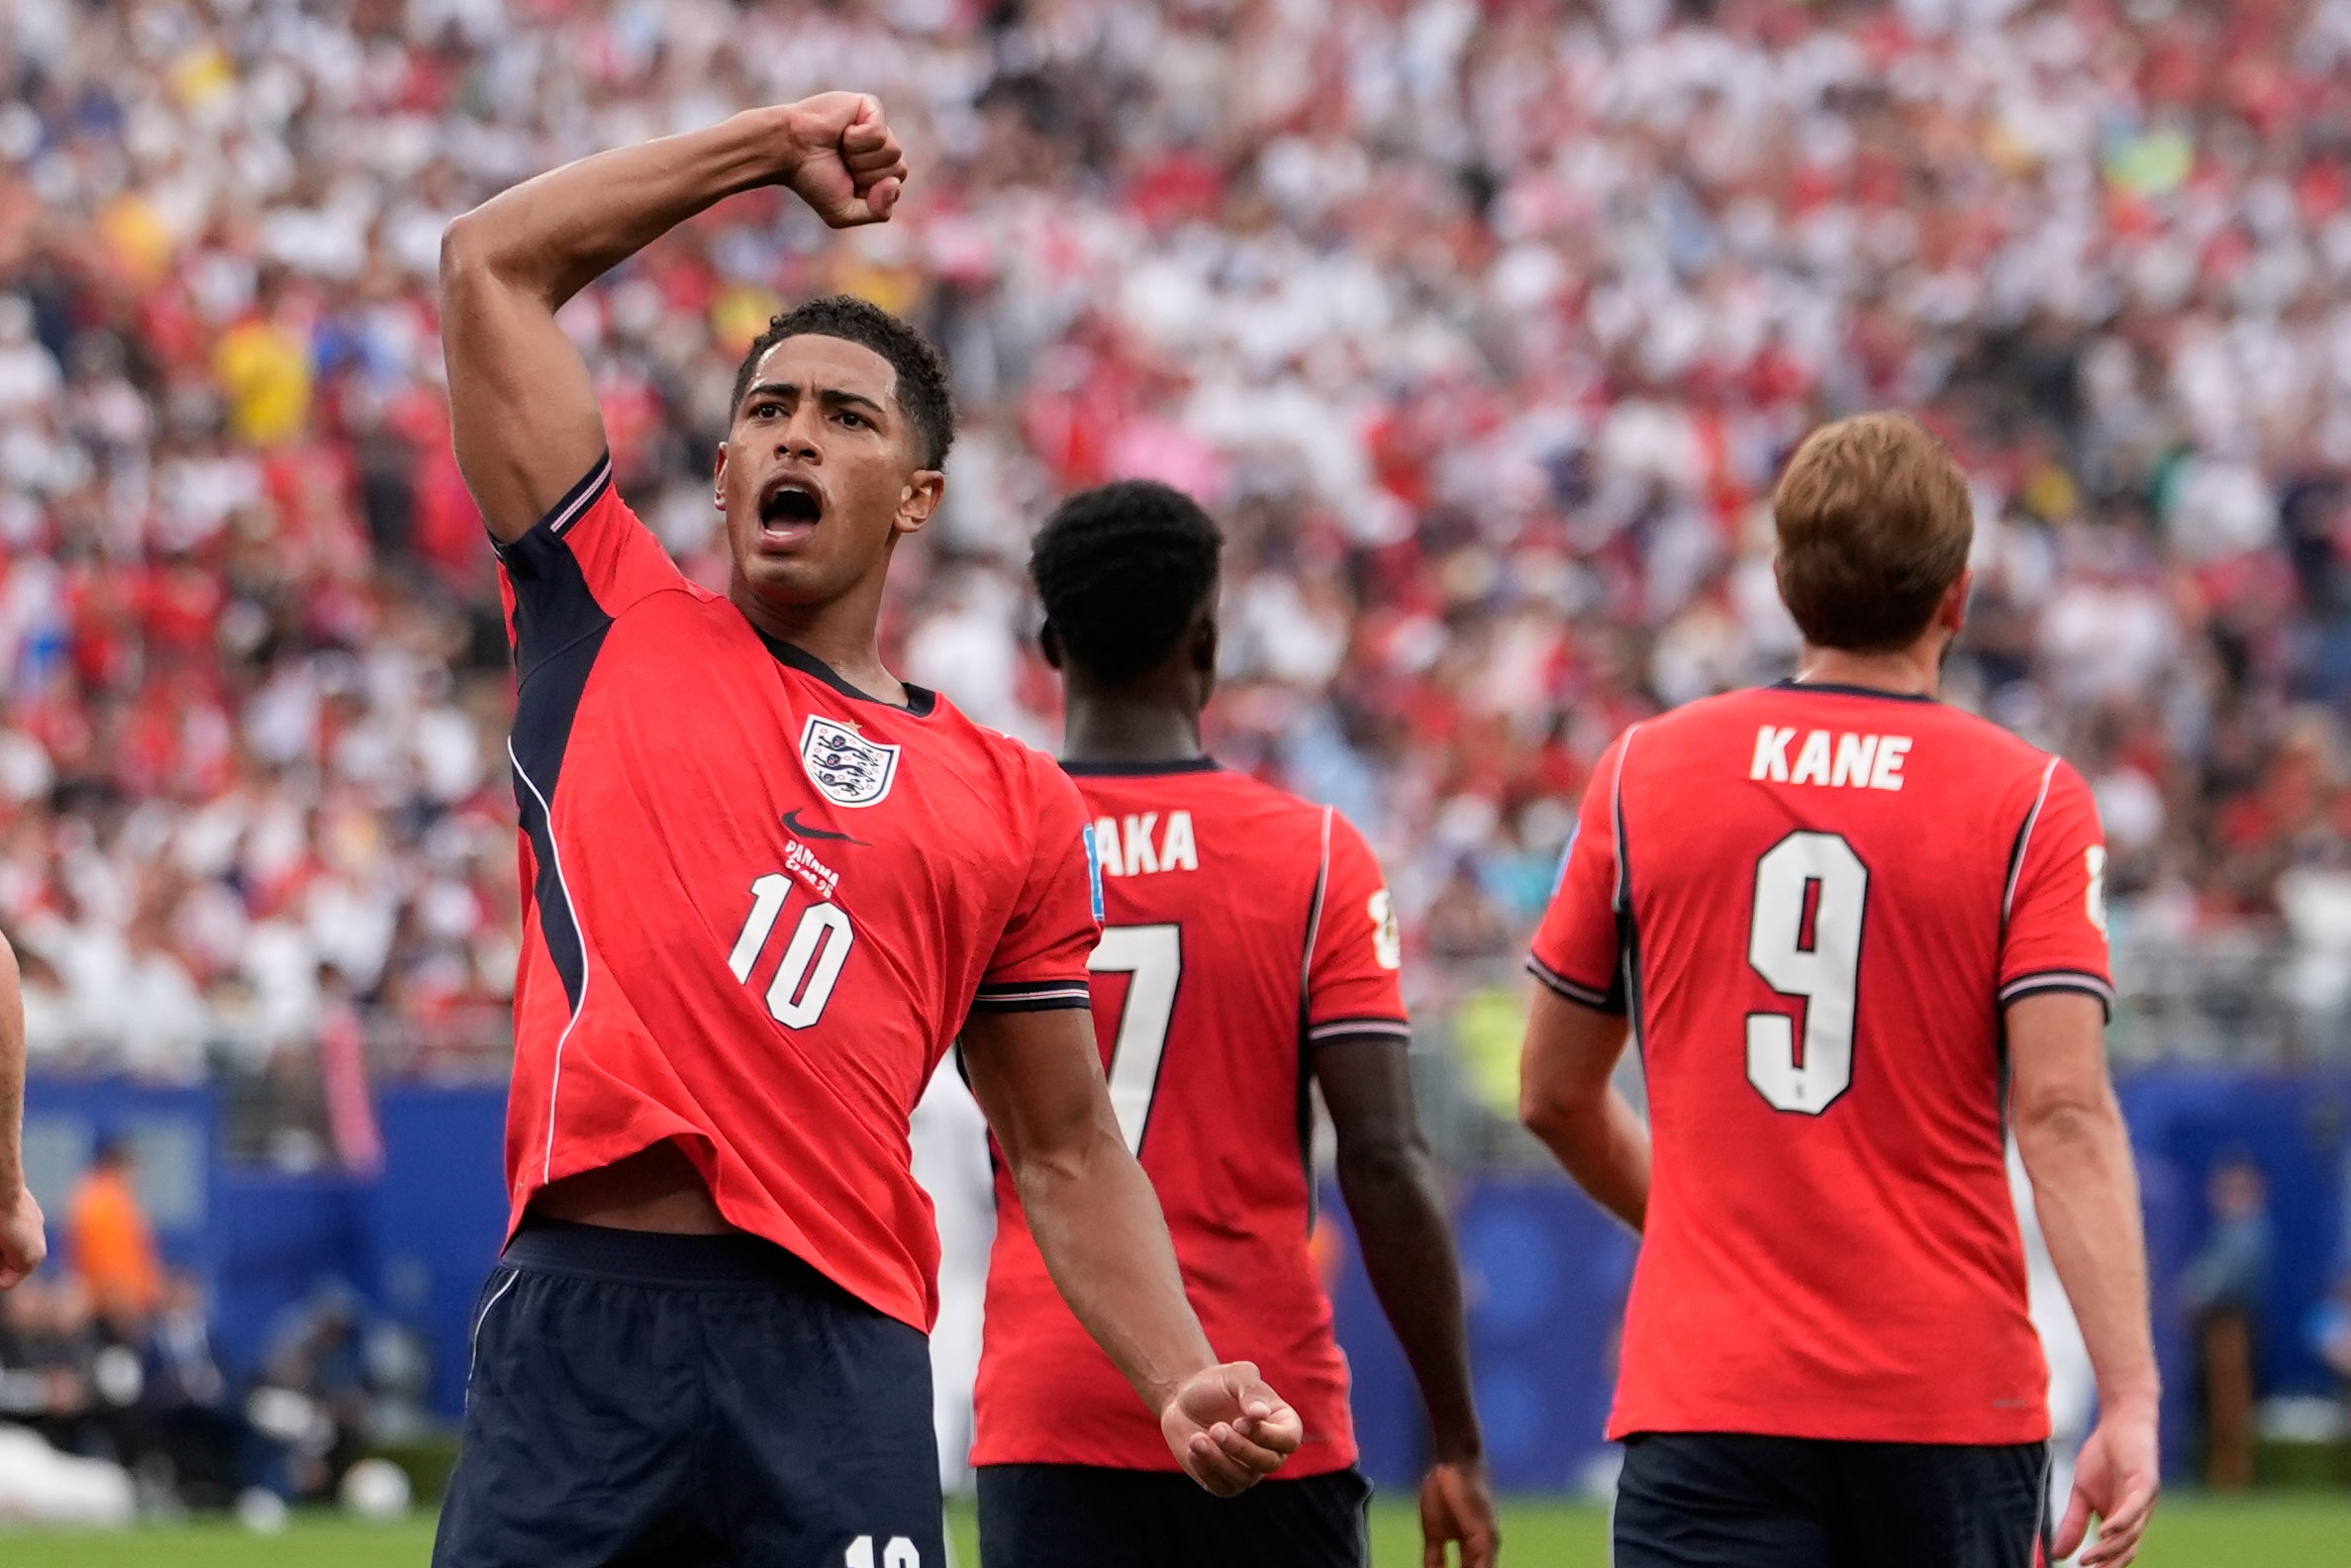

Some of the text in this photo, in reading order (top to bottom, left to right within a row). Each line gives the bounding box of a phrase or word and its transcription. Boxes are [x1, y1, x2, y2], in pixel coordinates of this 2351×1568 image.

[1749, 725, 1912, 791] KANE
[785, 838, 839, 887] PANAMA
[1094, 811, 1199, 877] AKA
[728, 872, 855, 1030] 10
[1745, 829, 1869, 1116] 9
[1085, 924, 1182, 1159] 7
